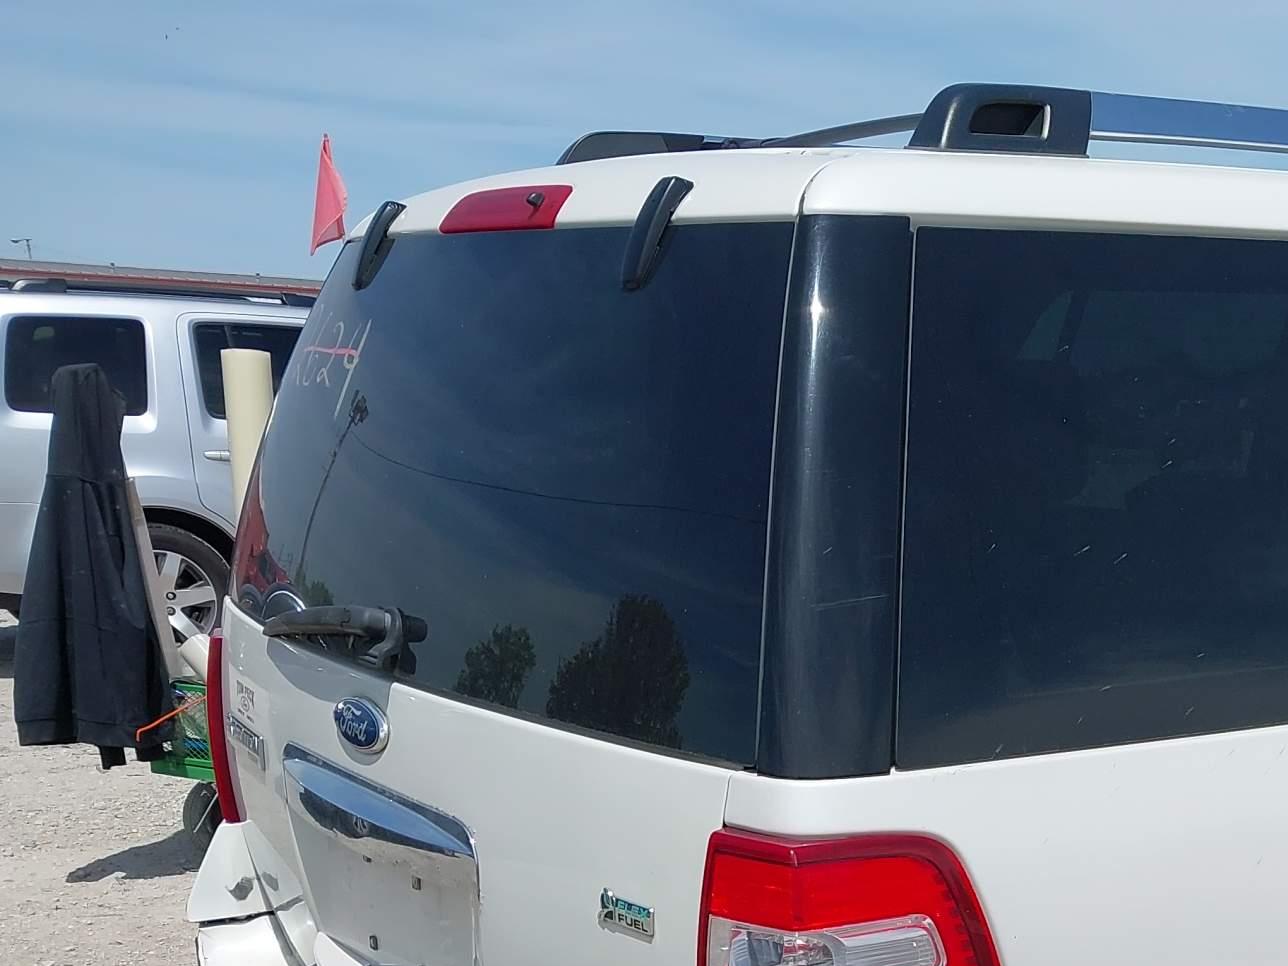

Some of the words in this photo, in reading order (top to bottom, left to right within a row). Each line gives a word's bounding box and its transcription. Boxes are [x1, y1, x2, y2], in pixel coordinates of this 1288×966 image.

[340, 703, 369, 742] Ford
[617, 899, 650, 919] FLEX
[617, 912, 649, 933] FUEL
